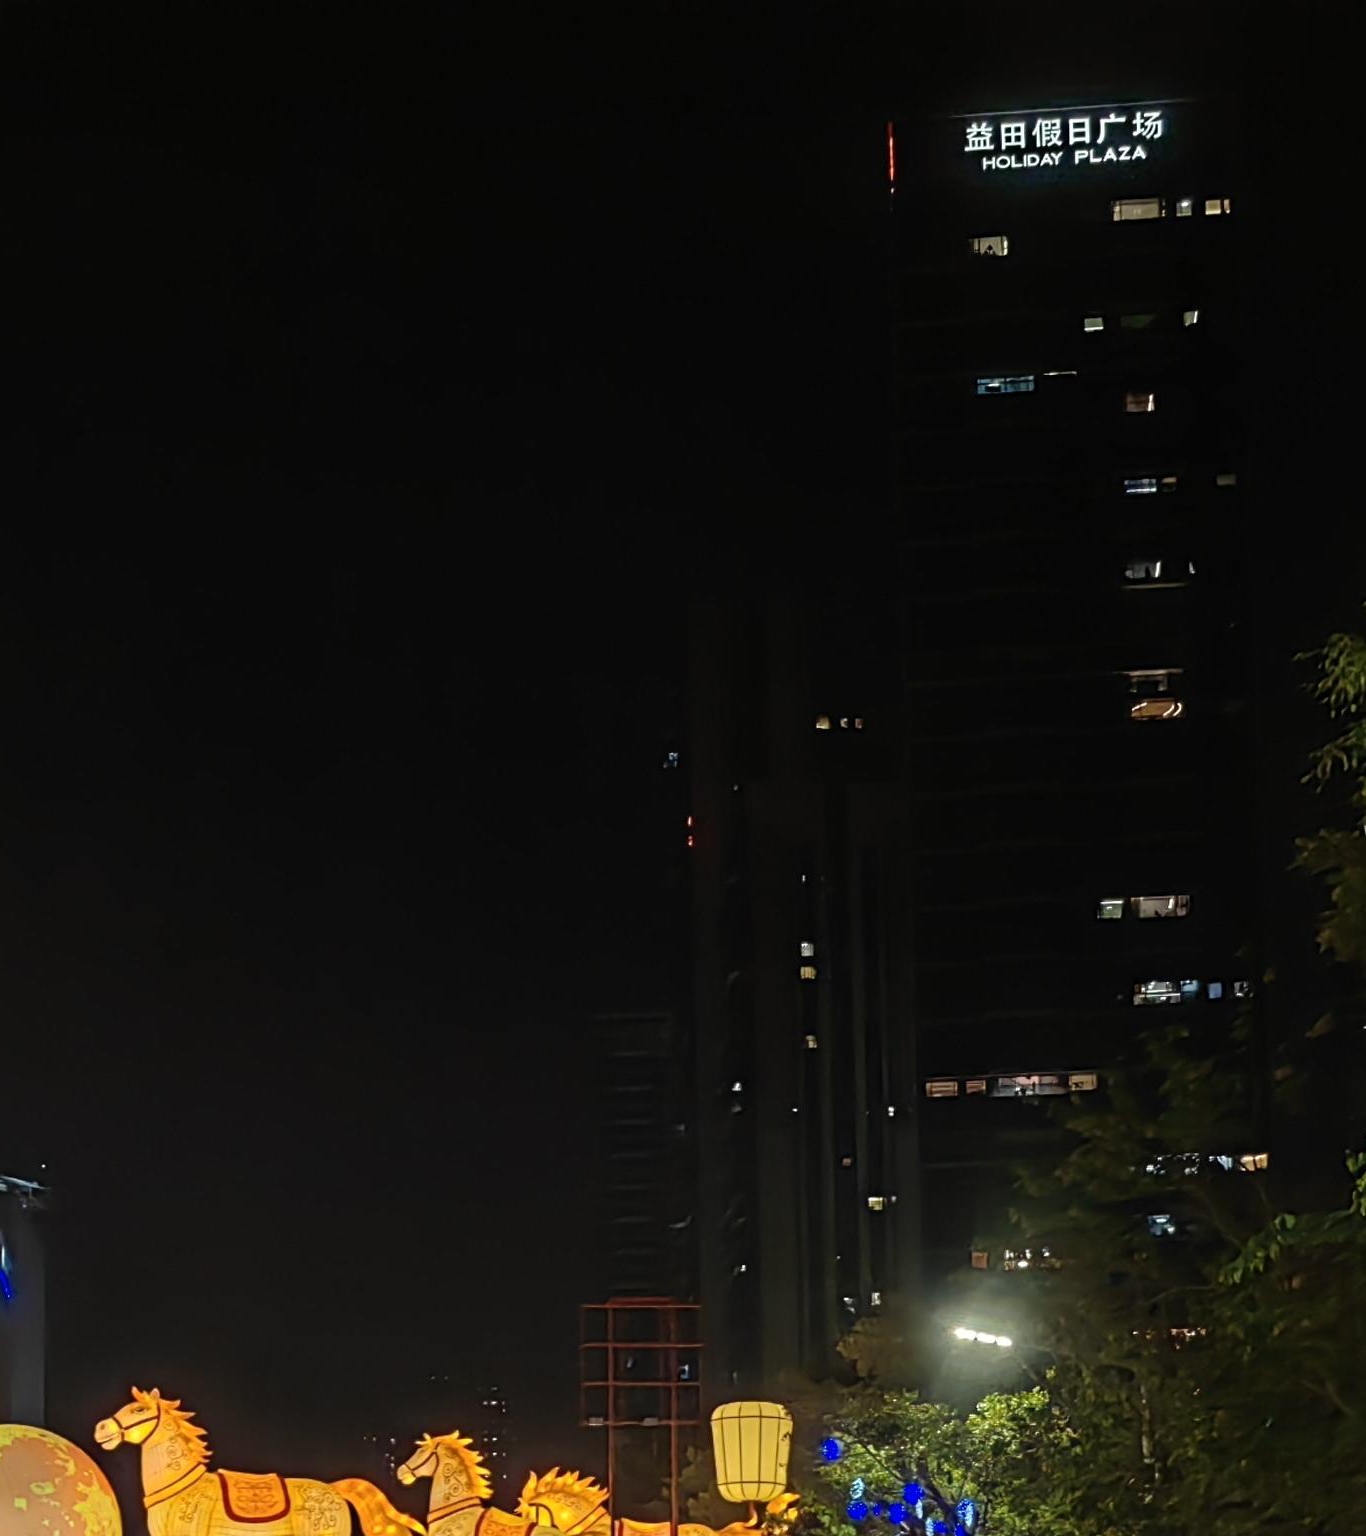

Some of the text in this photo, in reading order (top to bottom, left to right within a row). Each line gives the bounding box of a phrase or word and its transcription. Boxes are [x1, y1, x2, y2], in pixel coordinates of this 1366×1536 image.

[964, 111, 1163, 152] 益田假日广场
[982, 145, 1147, 171] HOLIDAY PLAZA
